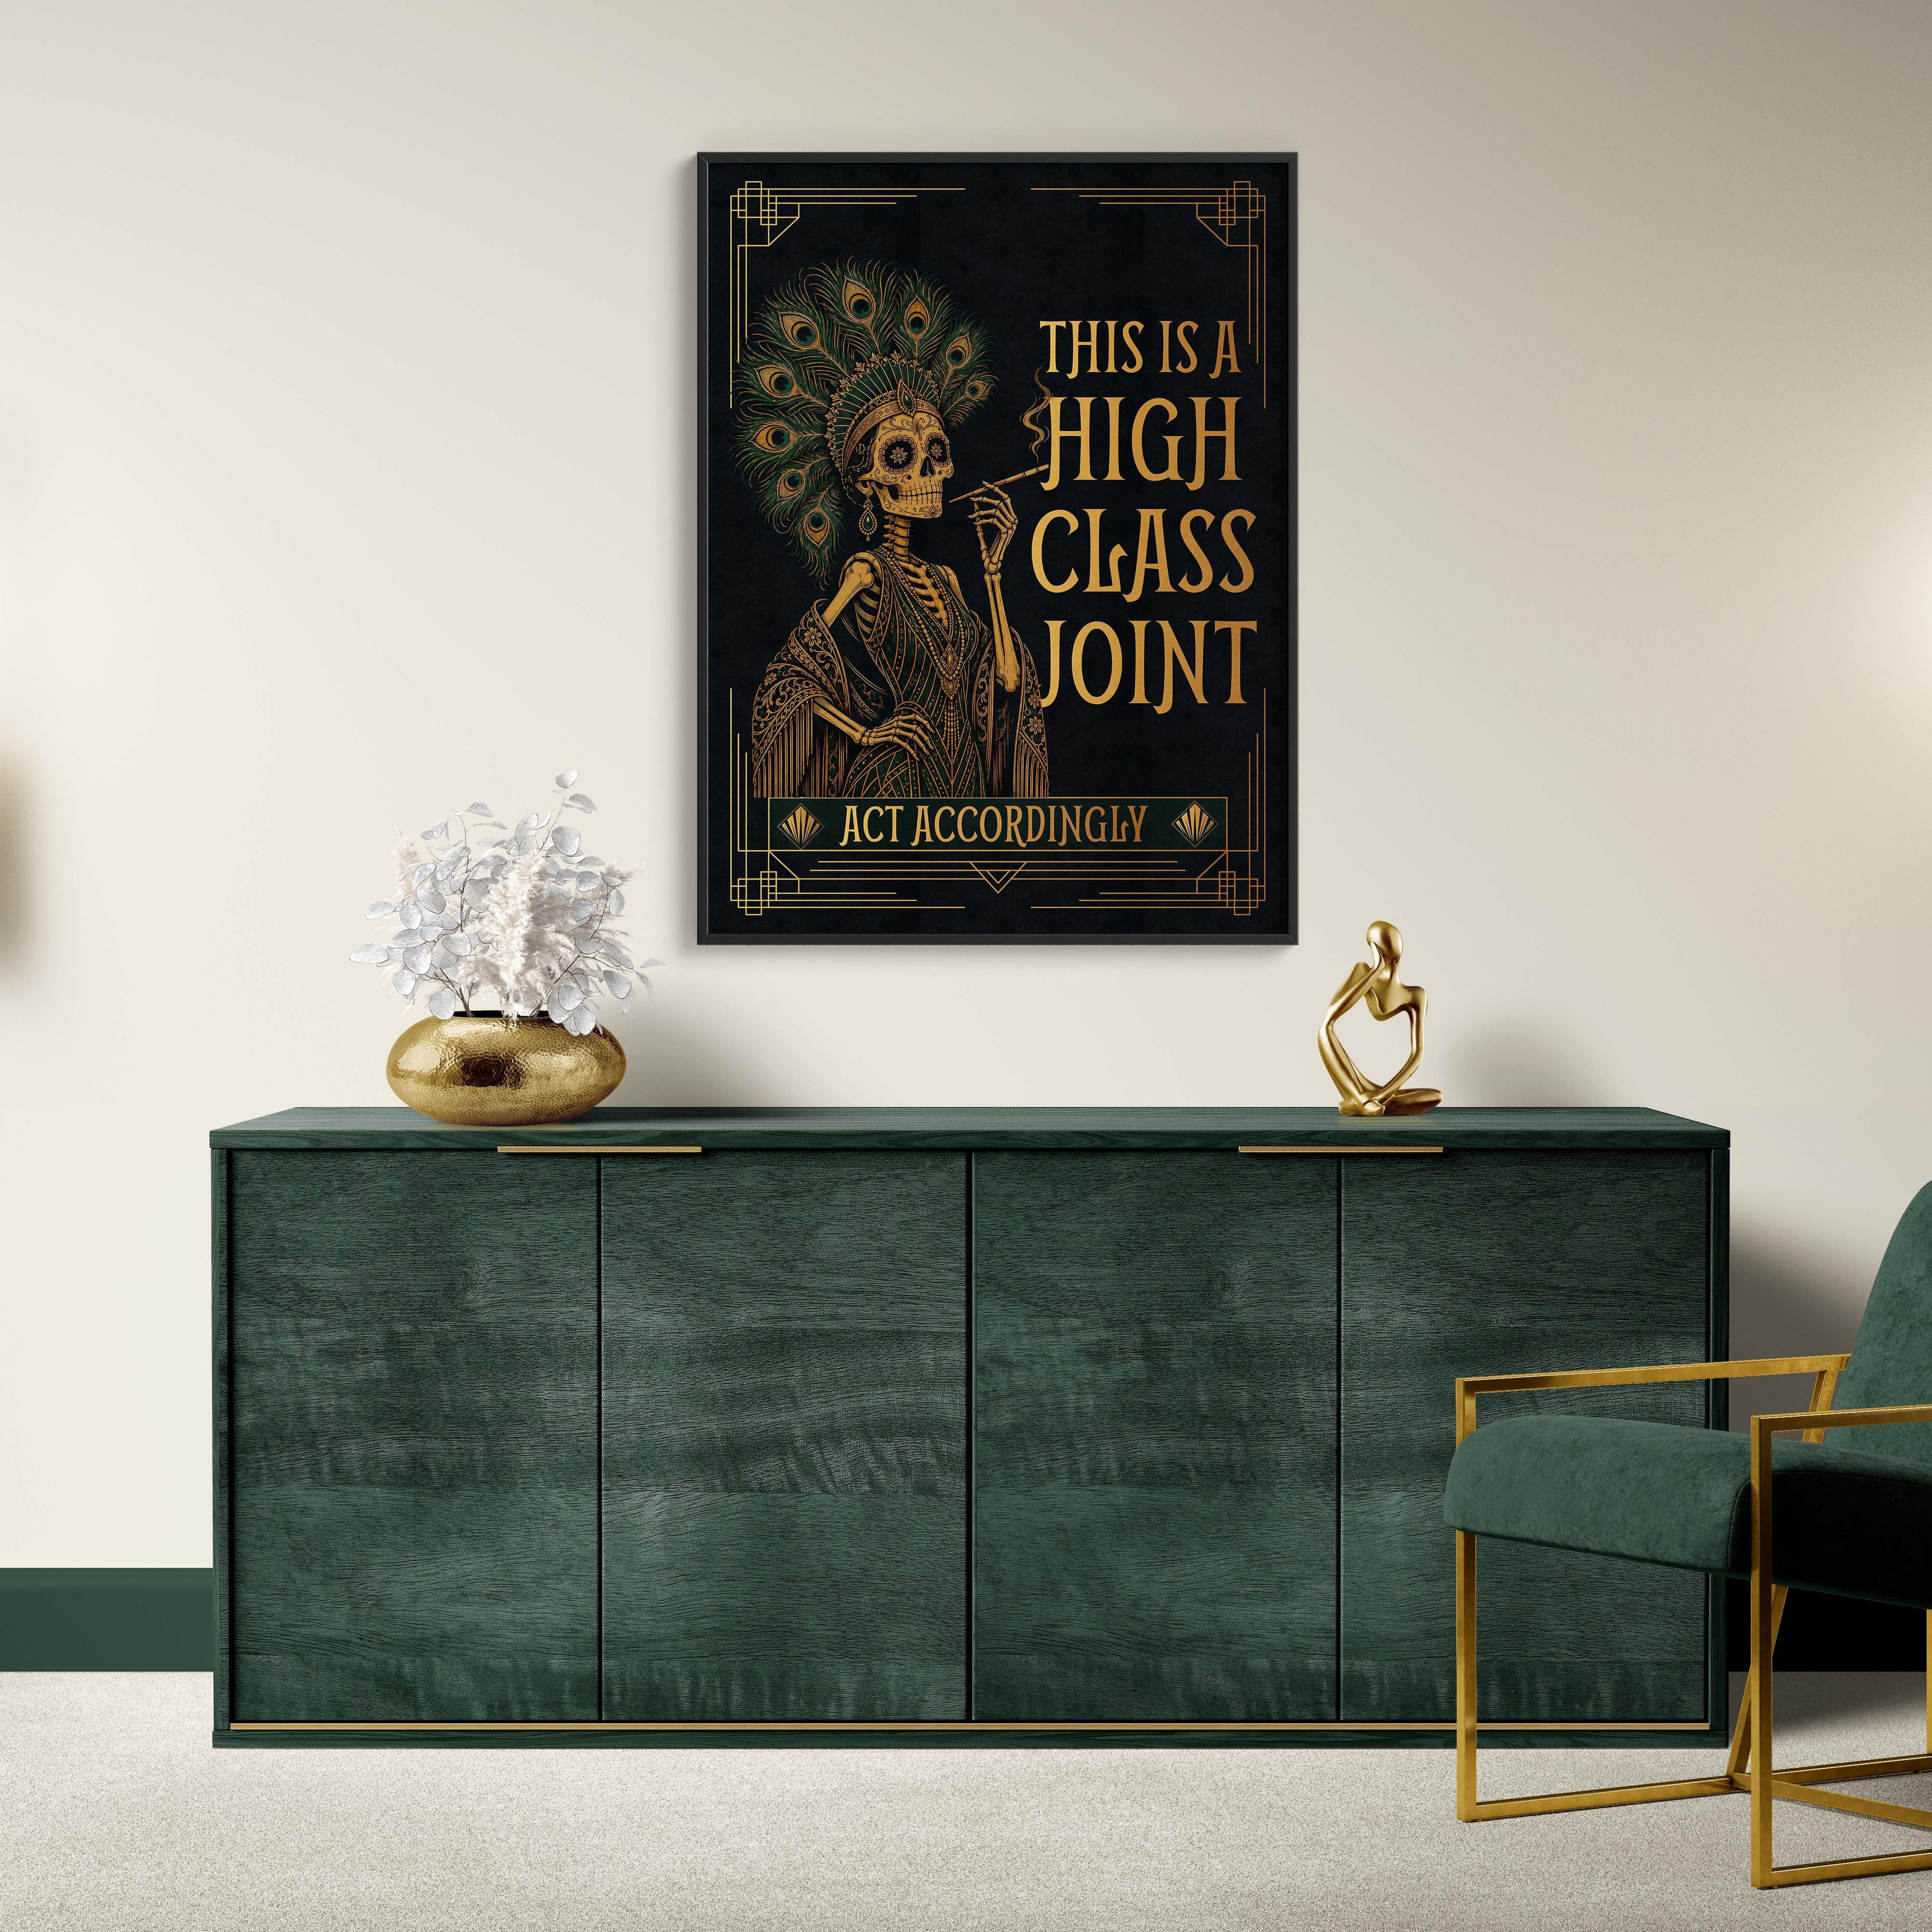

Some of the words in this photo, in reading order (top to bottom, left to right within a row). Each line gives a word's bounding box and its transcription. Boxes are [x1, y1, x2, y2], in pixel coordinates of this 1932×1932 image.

[1040, 321, 1144, 379] THIS
[1159, 321, 1198, 373] IS
[1209, 321, 1241, 379] A
[1040, 397, 1242, 491] HIGH
[1032, 509, 1256, 602] CLASS
[1040, 620, 1257, 714] JOINT
[839, 806, 904, 846] ACT
[911, 806, 1148, 847] ACCORDINGLY
